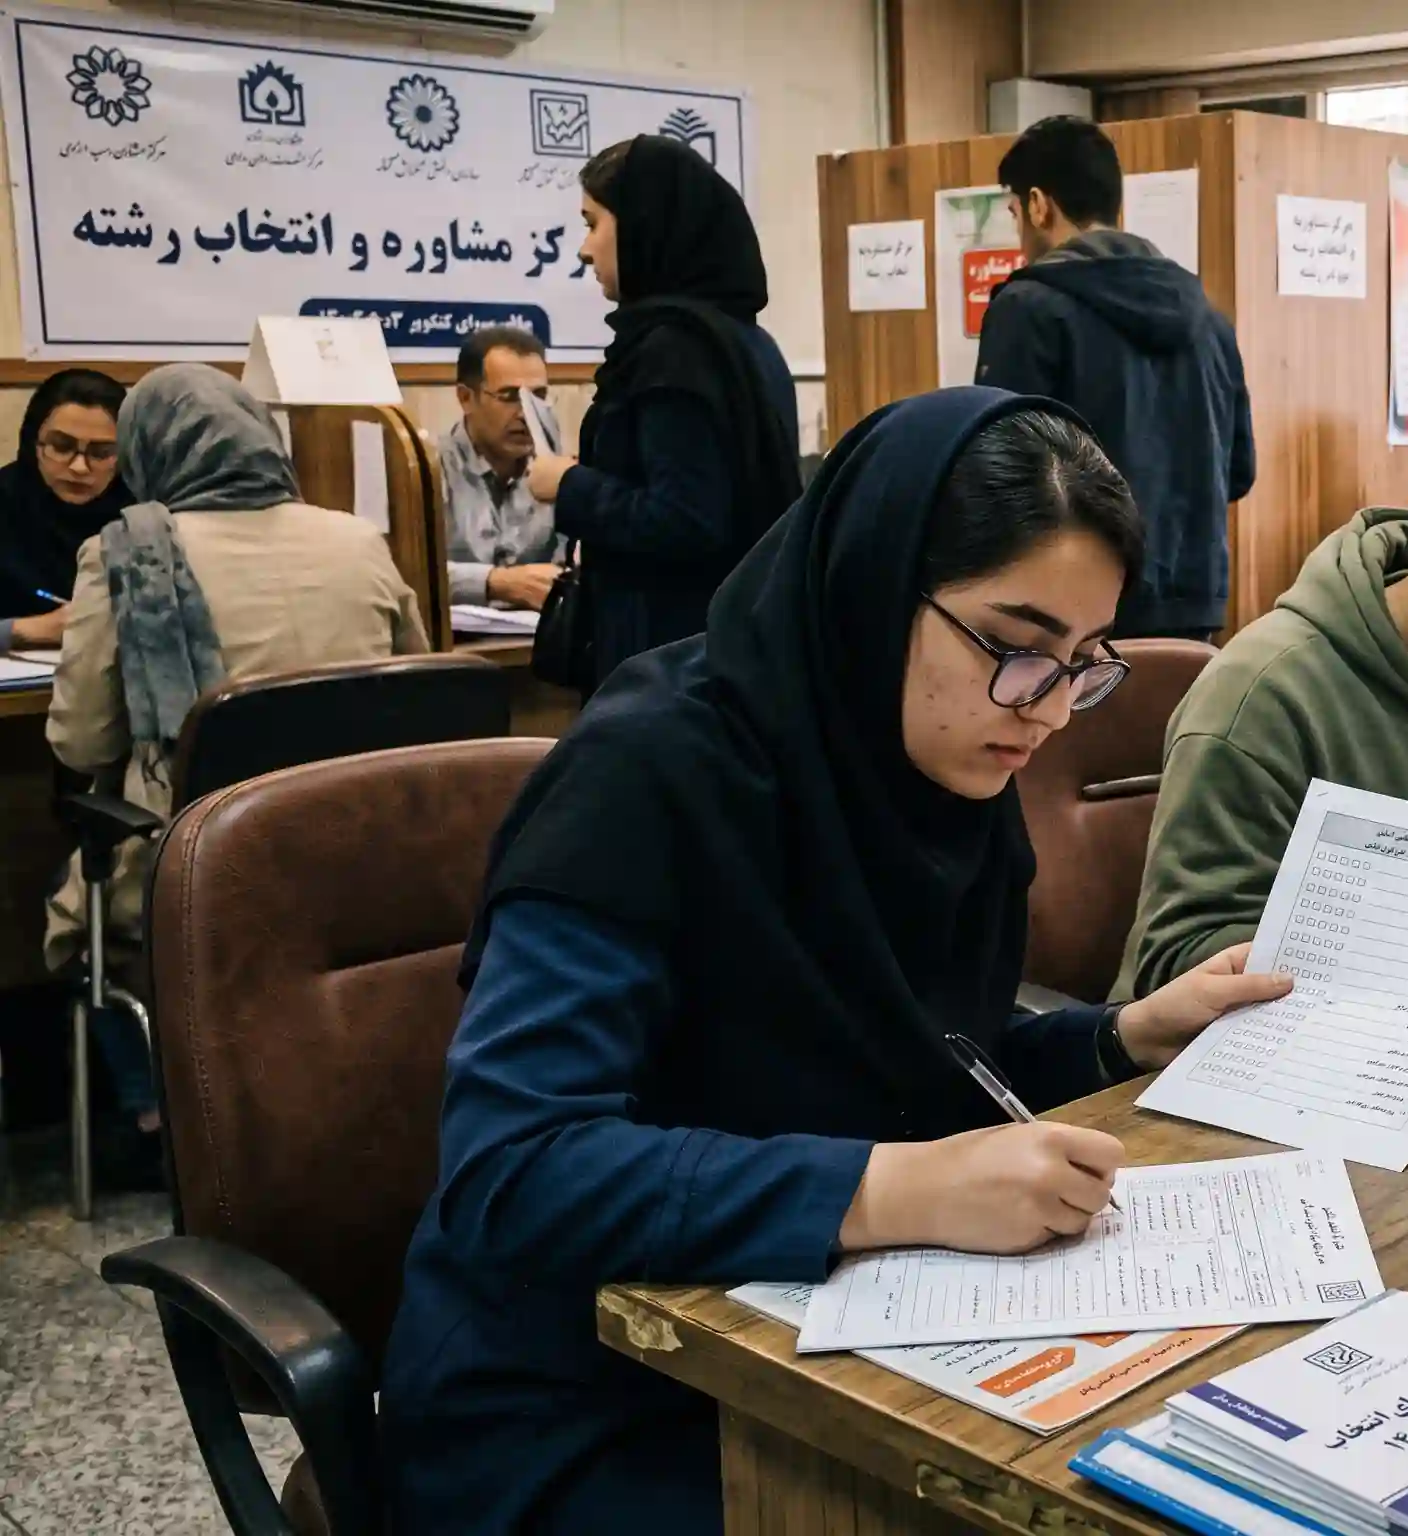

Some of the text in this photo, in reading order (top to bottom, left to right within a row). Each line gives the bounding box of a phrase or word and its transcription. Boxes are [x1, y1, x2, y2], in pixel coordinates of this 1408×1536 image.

[73, 202, 588, 279] رکز مشاوره و انتخاب رشته
[1325, 1410, 1391, 1450] انتخاب
